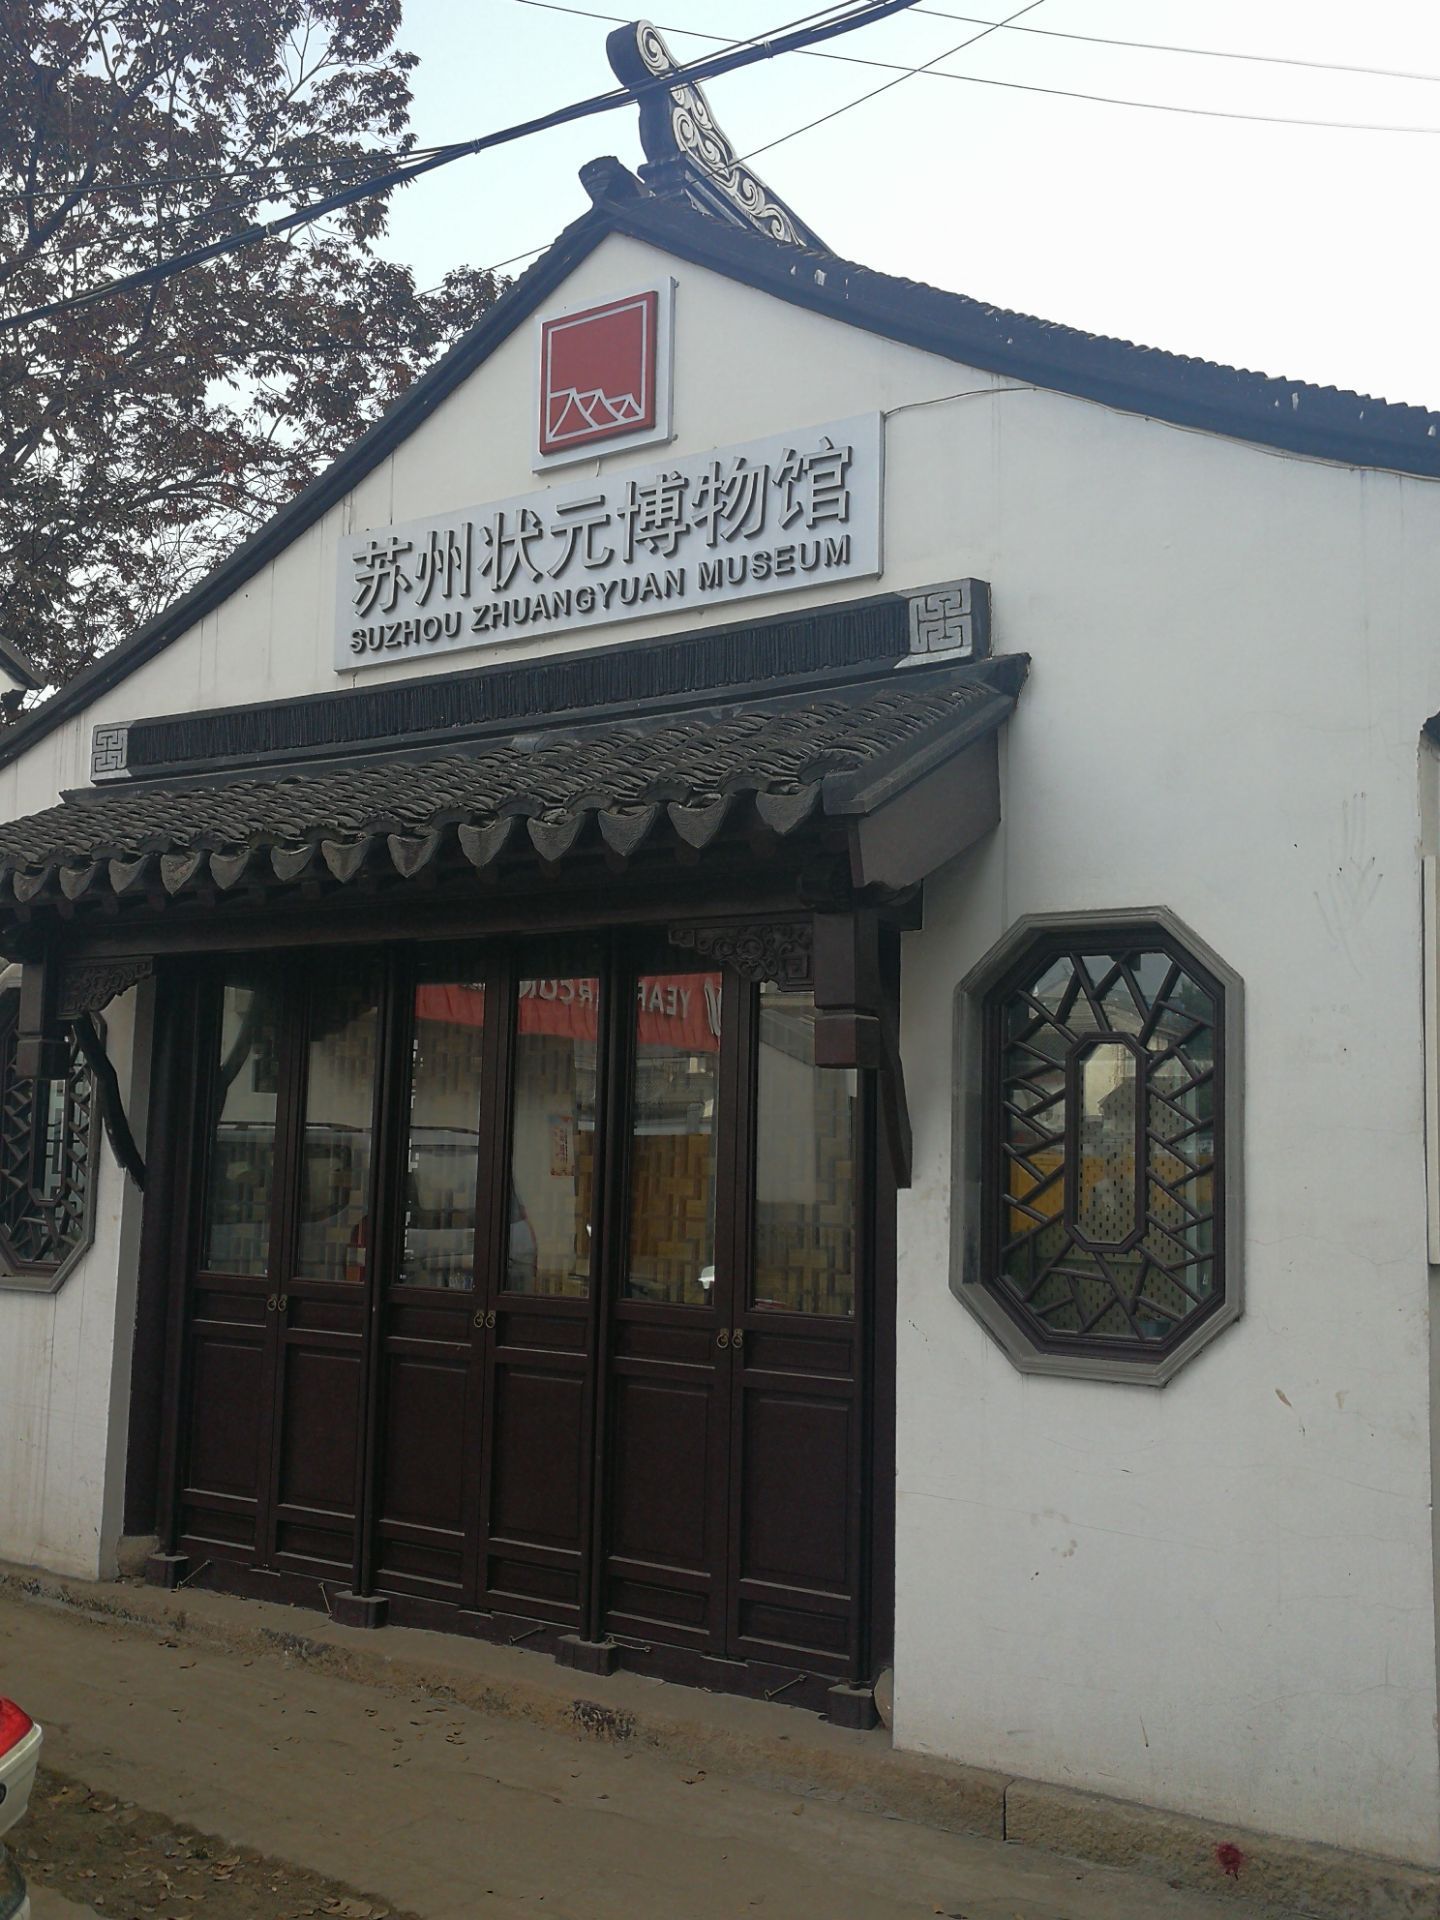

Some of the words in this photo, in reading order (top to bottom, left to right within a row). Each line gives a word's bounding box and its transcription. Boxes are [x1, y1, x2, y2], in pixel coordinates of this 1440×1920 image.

[350, 611, 462, 653] SUZHOU
[470, 567, 685, 632] ZHUANGYUAN
[698, 534, 851, 590] MUSEUM
[352, 436, 852, 617] 苏州状元博物馆
